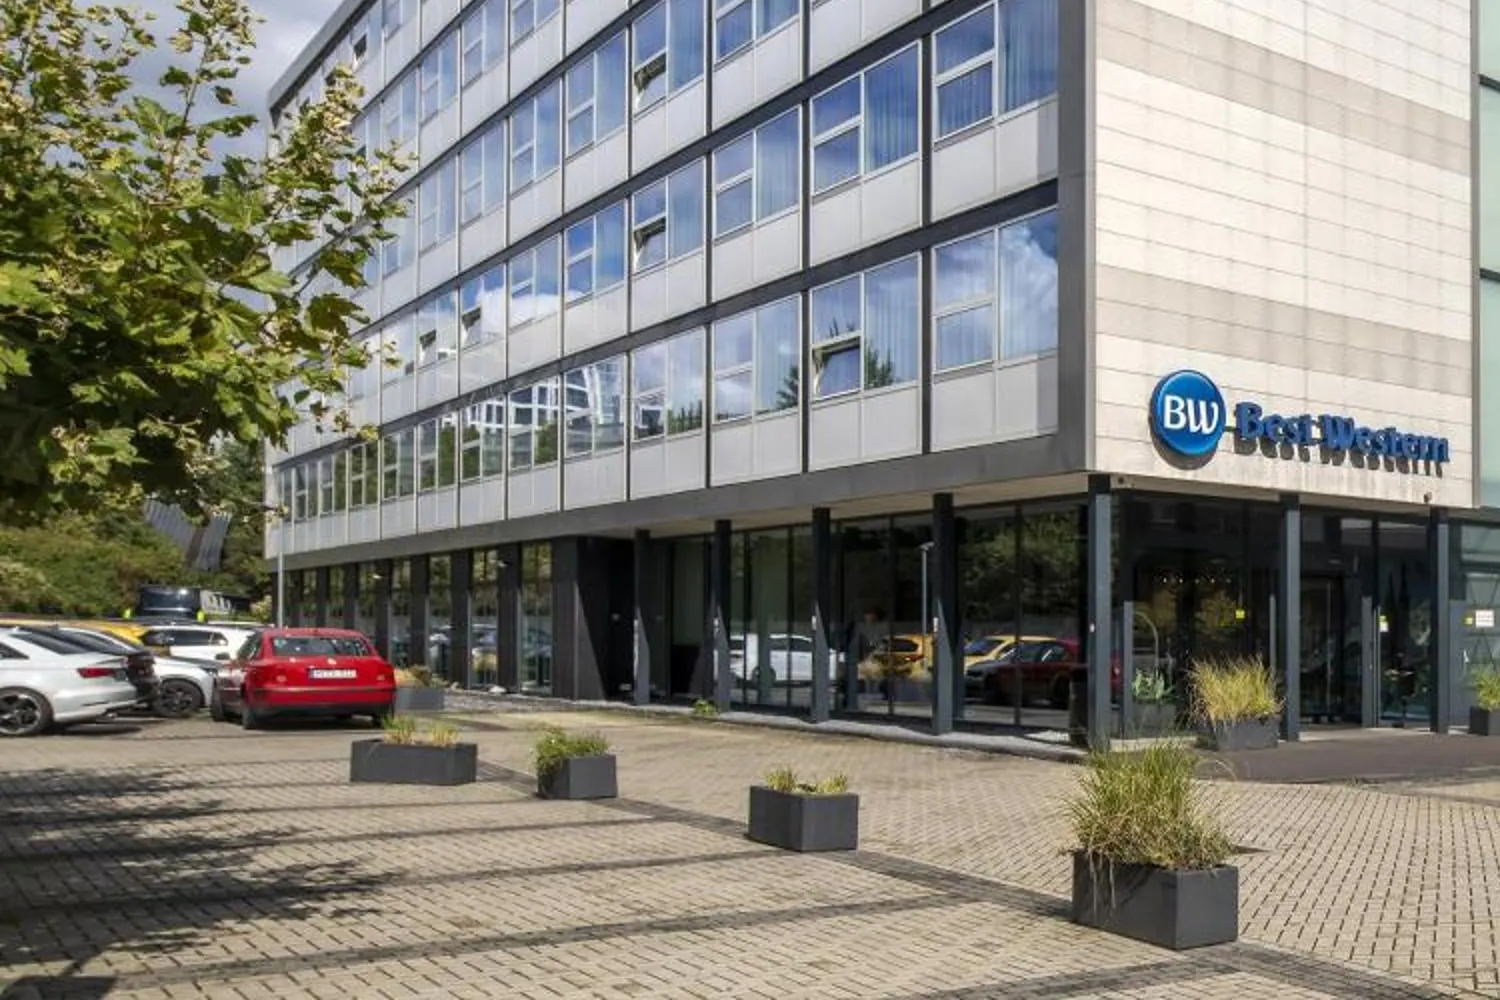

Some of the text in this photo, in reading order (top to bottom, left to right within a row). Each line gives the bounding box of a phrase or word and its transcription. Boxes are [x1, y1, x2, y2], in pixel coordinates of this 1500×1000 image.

[1163, 395, 1219, 435] BW
[1233, 401, 1450, 463] Best Western
